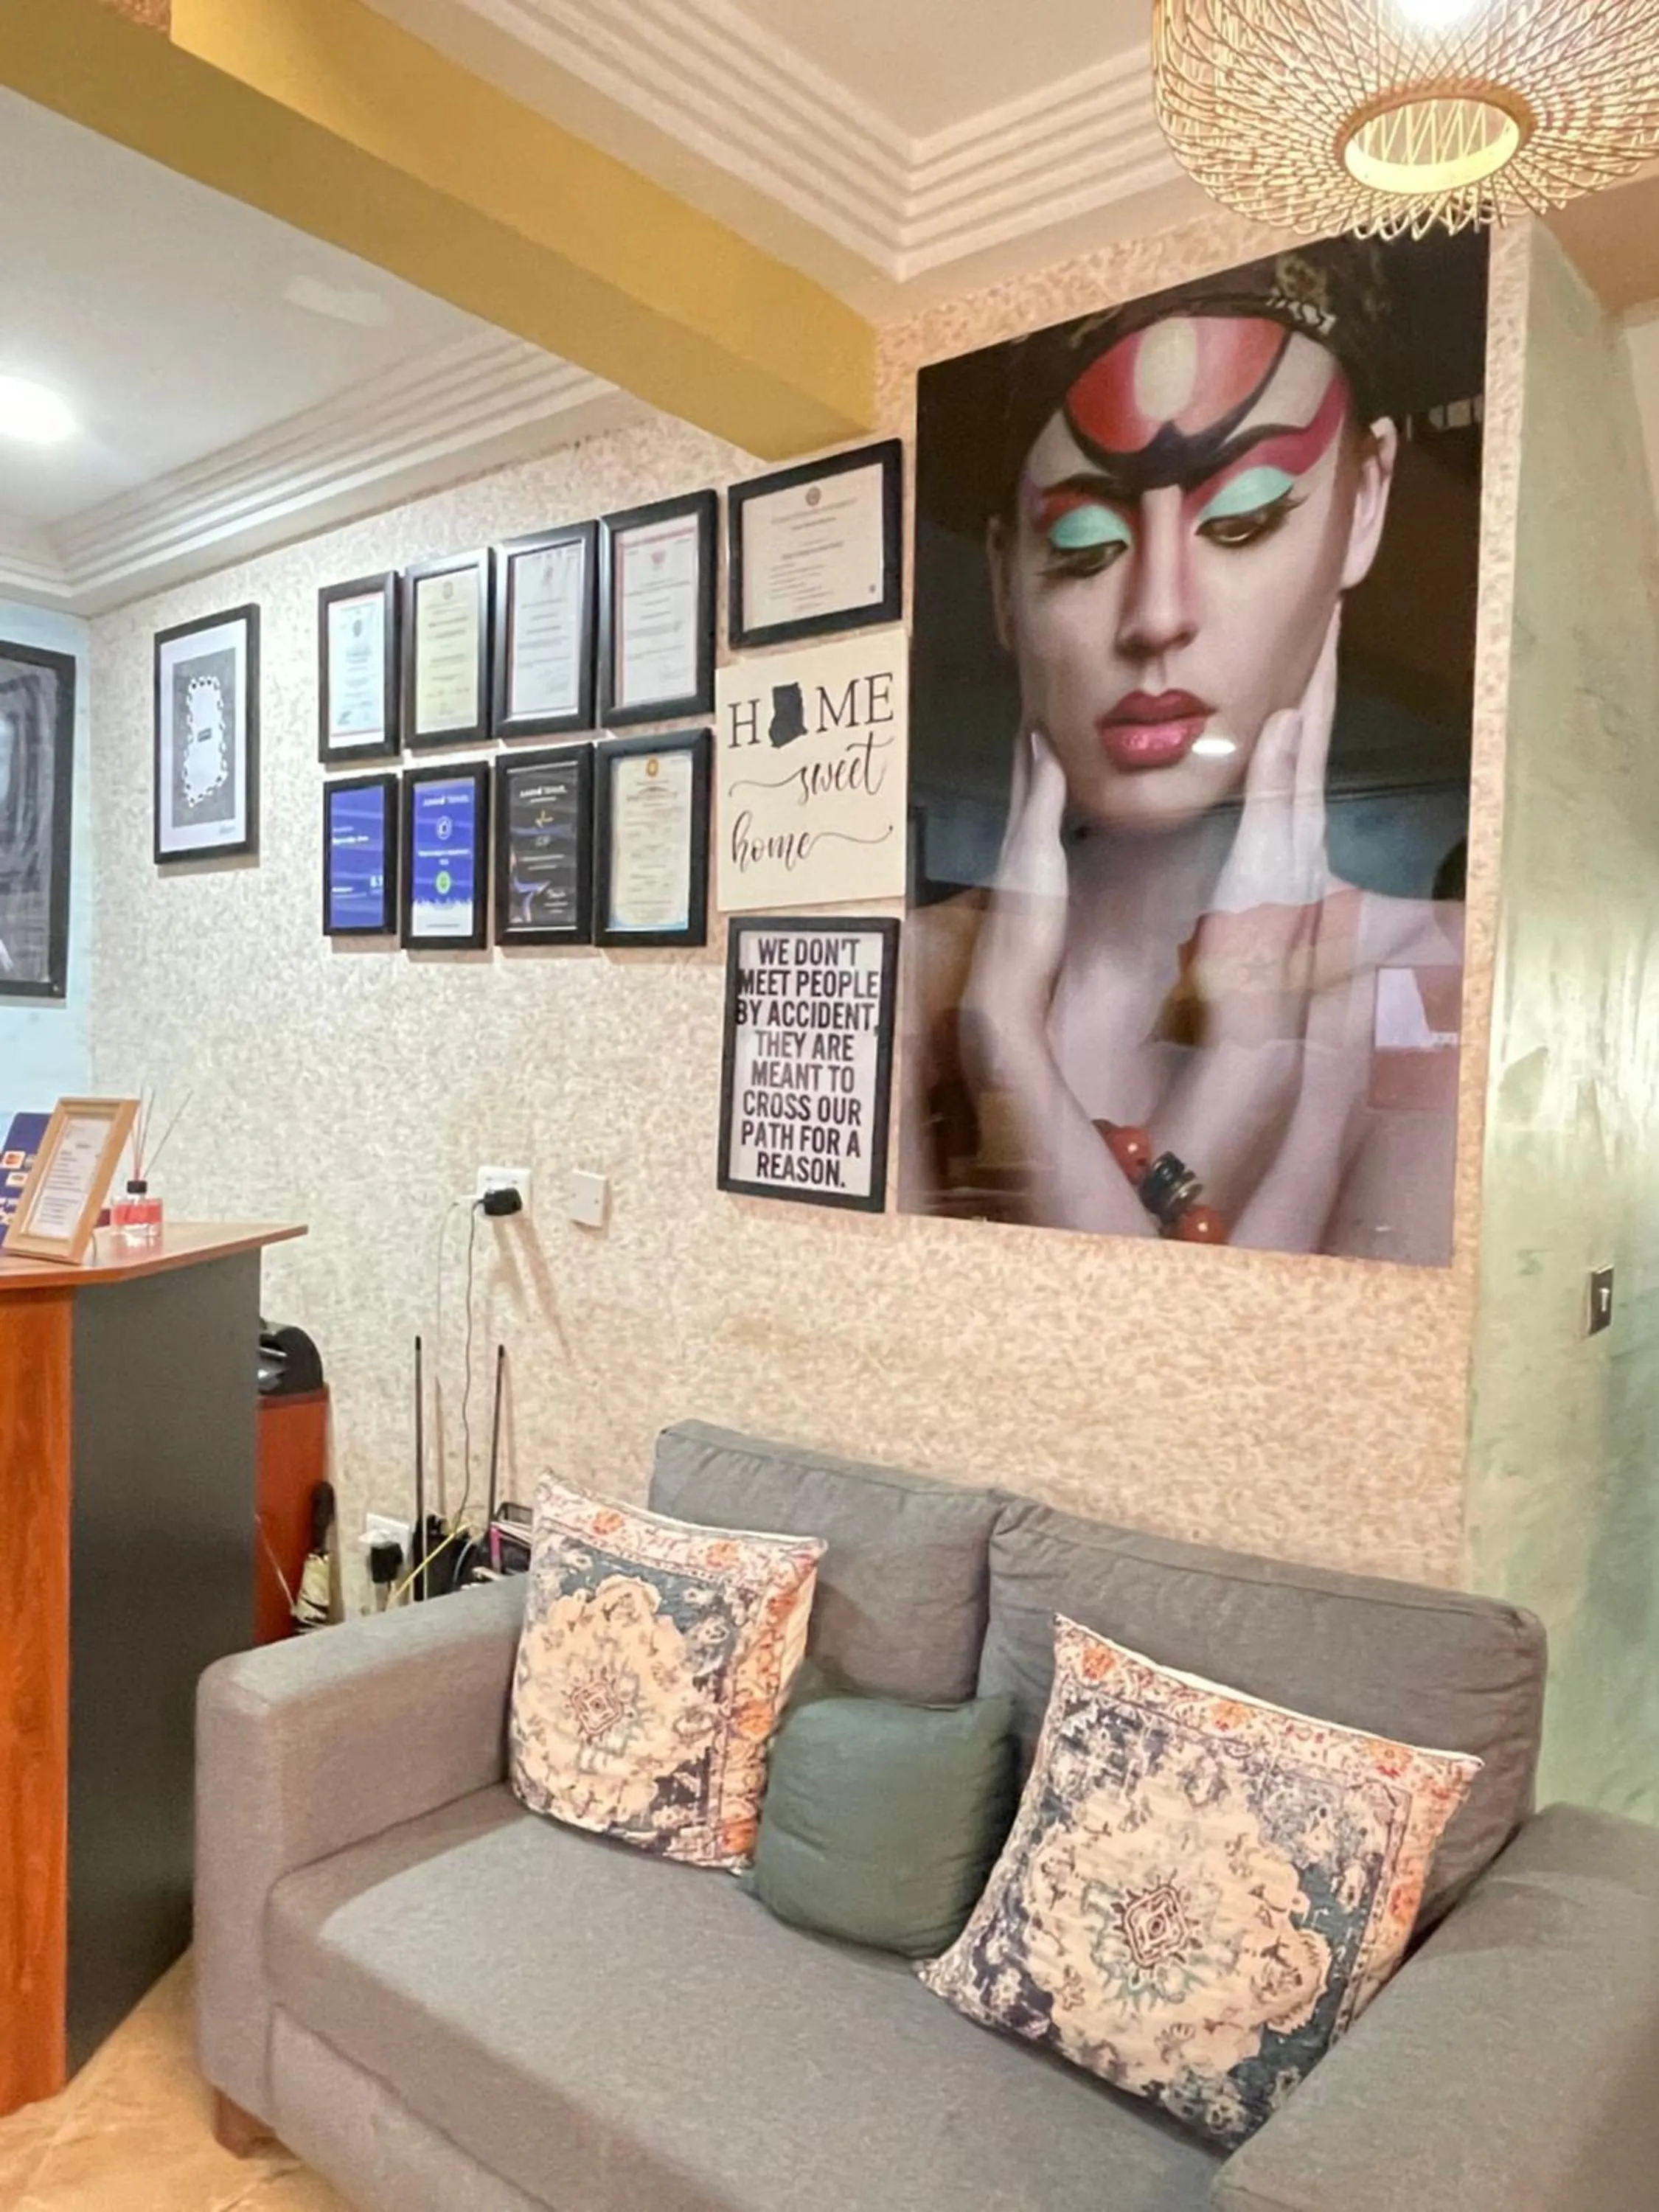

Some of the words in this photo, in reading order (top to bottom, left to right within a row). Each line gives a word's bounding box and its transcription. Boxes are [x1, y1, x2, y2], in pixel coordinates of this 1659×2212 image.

[728, 672, 894, 749] HME
[728, 731, 895, 806] sweet
[758, 939, 790, 965] WE
[794, 939, 860, 967] DON'T
[738, 970, 790, 996] MEET
[796, 970, 879, 998] PEOPLE
[736, 1000, 762, 1026] BY
[757, 1030, 806, 1058] THEY
[812, 1034, 855, 1061] ARE
[751, 1060, 823, 1091] MEANT
[828, 1065, 855, 1093] TO
[743, 1090, 811, 1121] CROSS
[818, 1096, 861, 1126] OUR
[741, 1120, 794, 1151] PATH
[800, 1126, 840, 1156] FOR
[846, 1130, 860, 1158] A
[757, 1151, 846, 1188] REASON.
